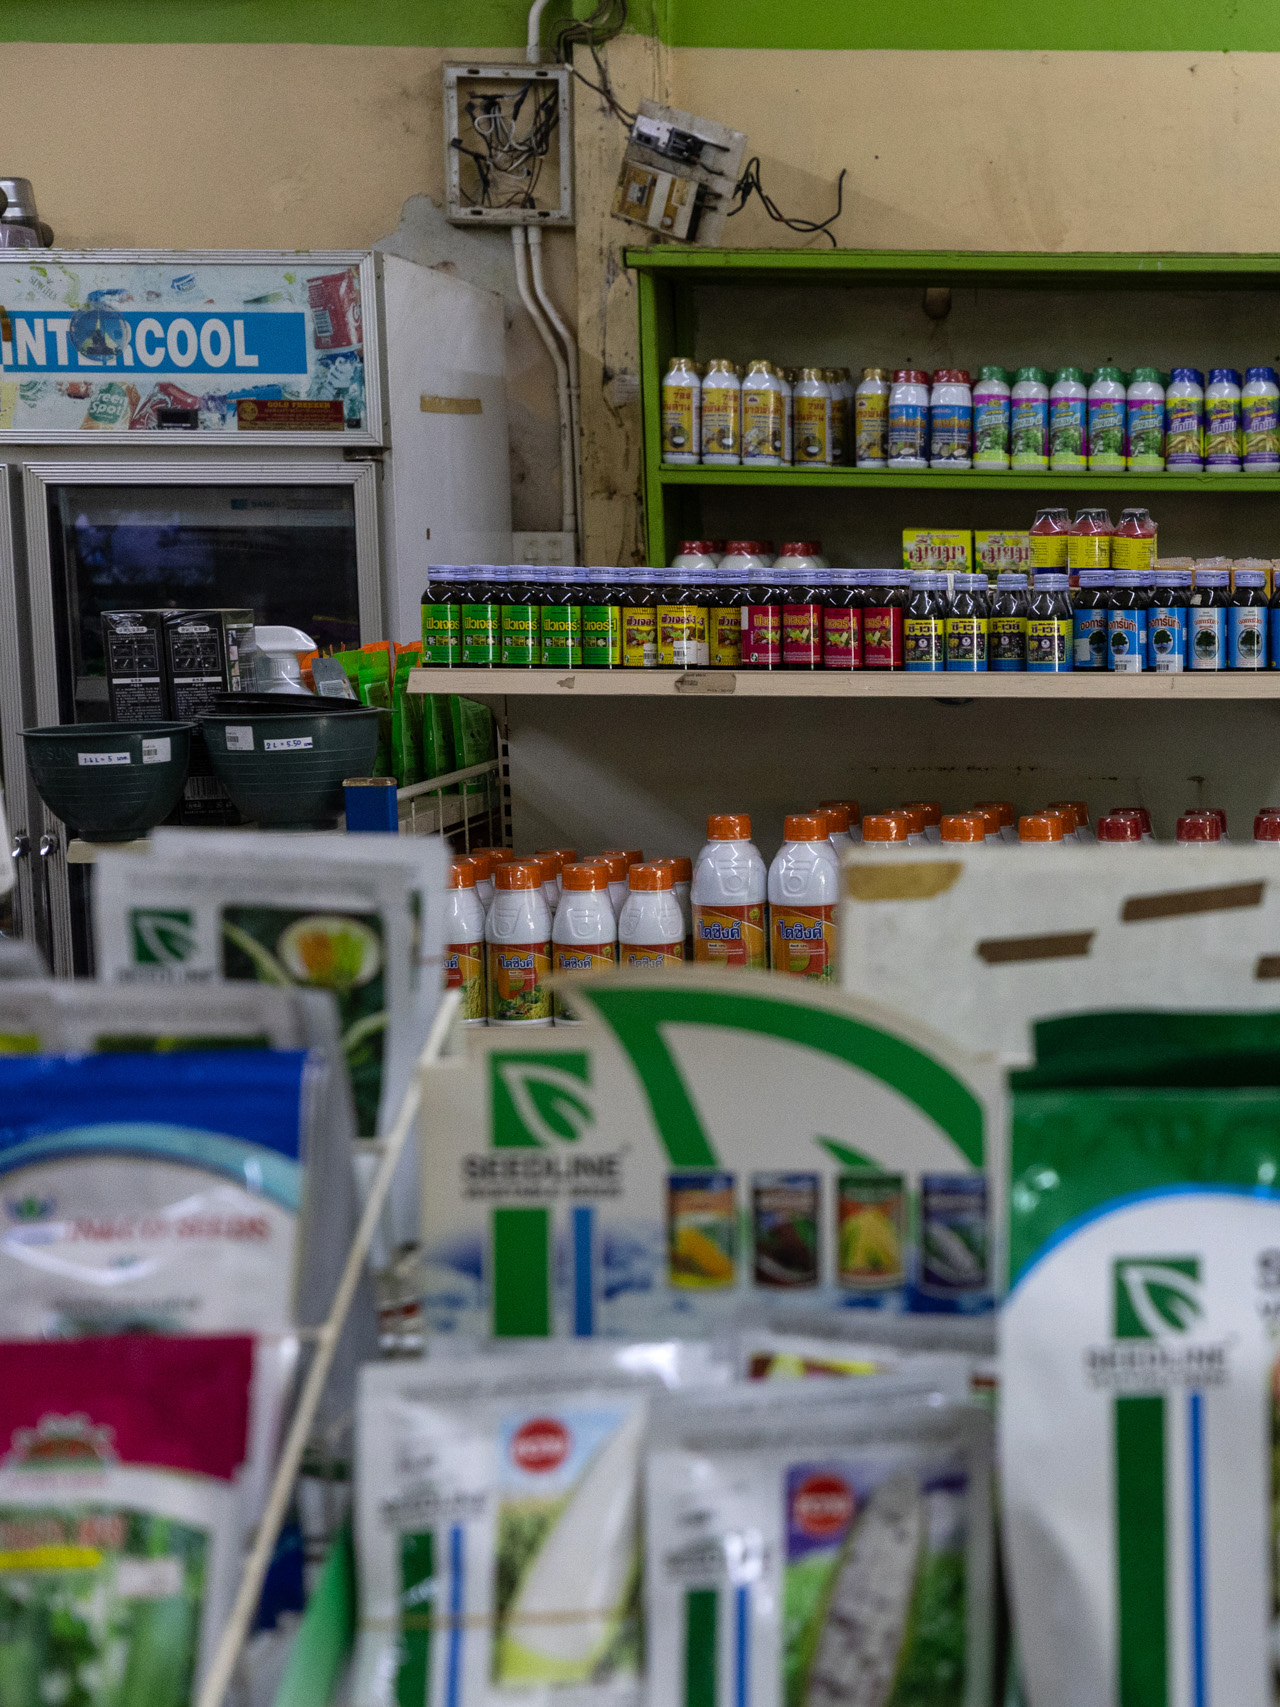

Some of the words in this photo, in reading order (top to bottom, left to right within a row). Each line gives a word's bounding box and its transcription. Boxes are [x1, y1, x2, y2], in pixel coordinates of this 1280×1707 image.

[426, 616, 460, 631] ฟิวเจอร์
[582, 618, 617, 632] วเจอร์-1
[1080, 616, 1108, 630] ออการ์
[778, 919, 824, 940] ไดซิงค์
[462, 1152, 621, 1179] SEEDLINE
